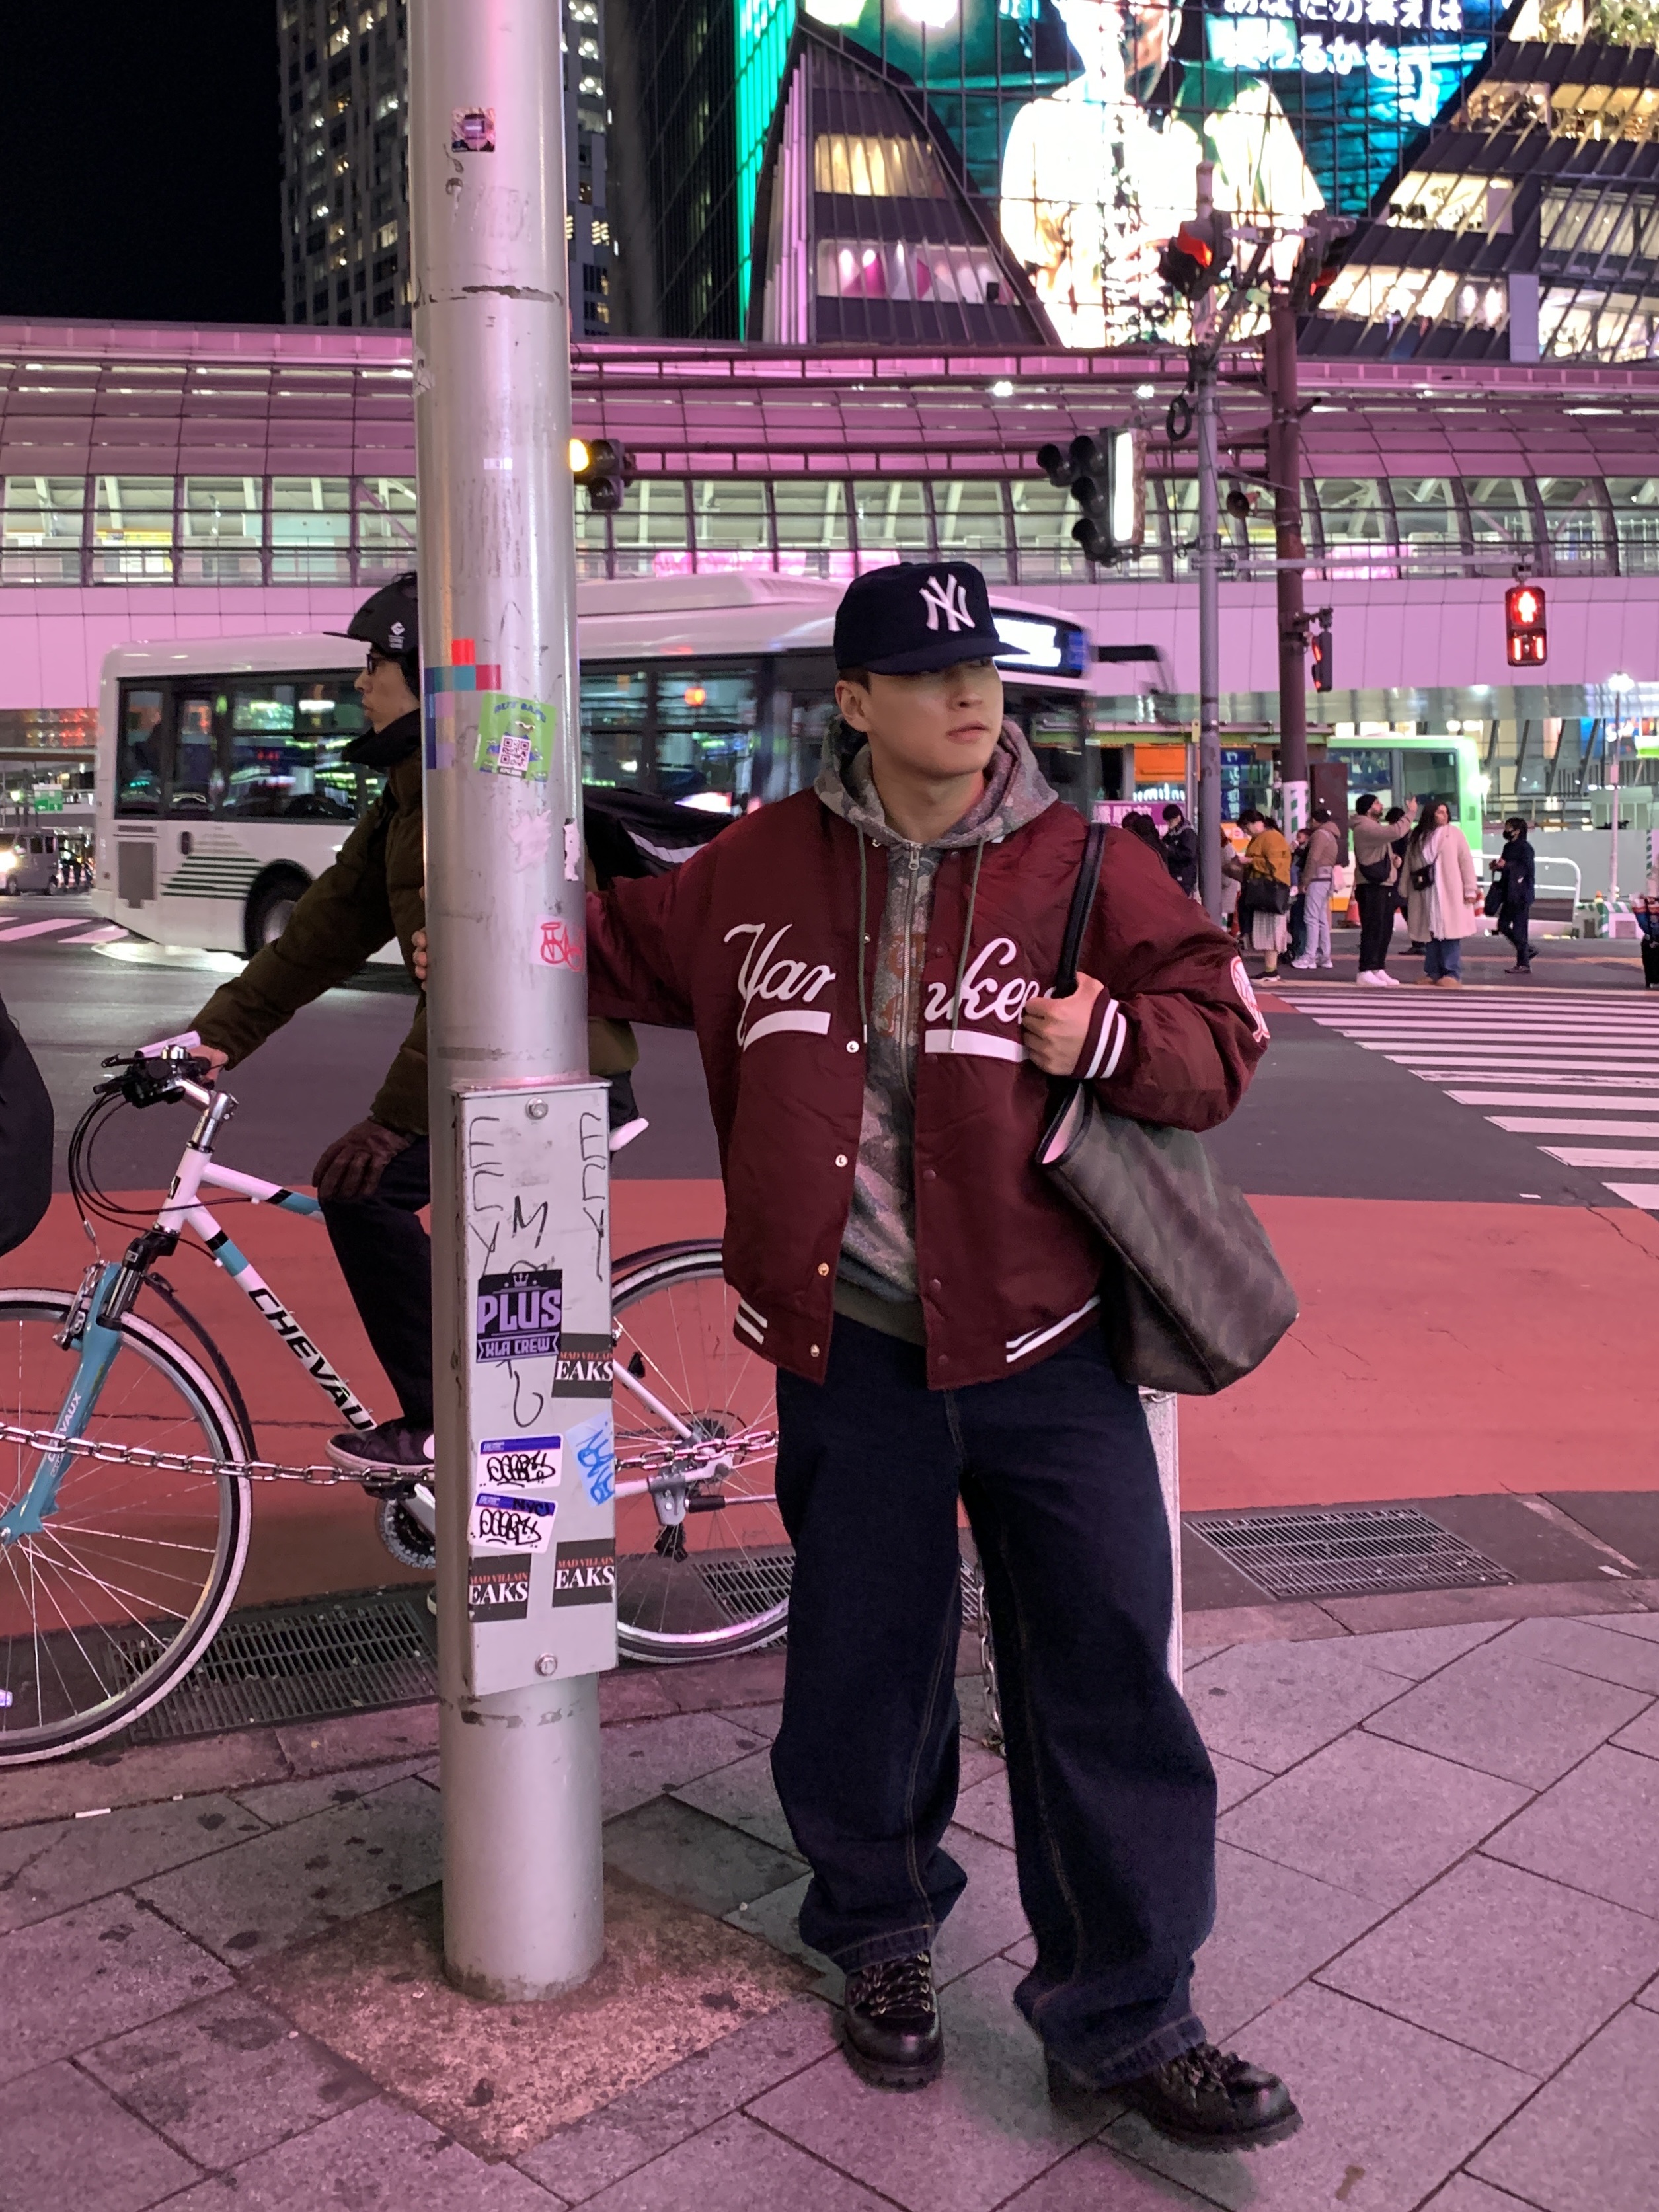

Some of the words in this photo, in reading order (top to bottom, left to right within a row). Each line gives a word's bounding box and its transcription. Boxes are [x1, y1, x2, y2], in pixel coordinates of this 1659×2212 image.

[919, 573, 976, 632] NY
[477, 1289, 562, 1334] PLUS
[514, 1336, 550, 1355] CREW
[555, 1360, 614, 1382] EAKS
[558, 1558, 579, 1569] MAD
[555, 1565, 615, 1590] EAKS
[469, 1581, 528, 1605] EAKS
